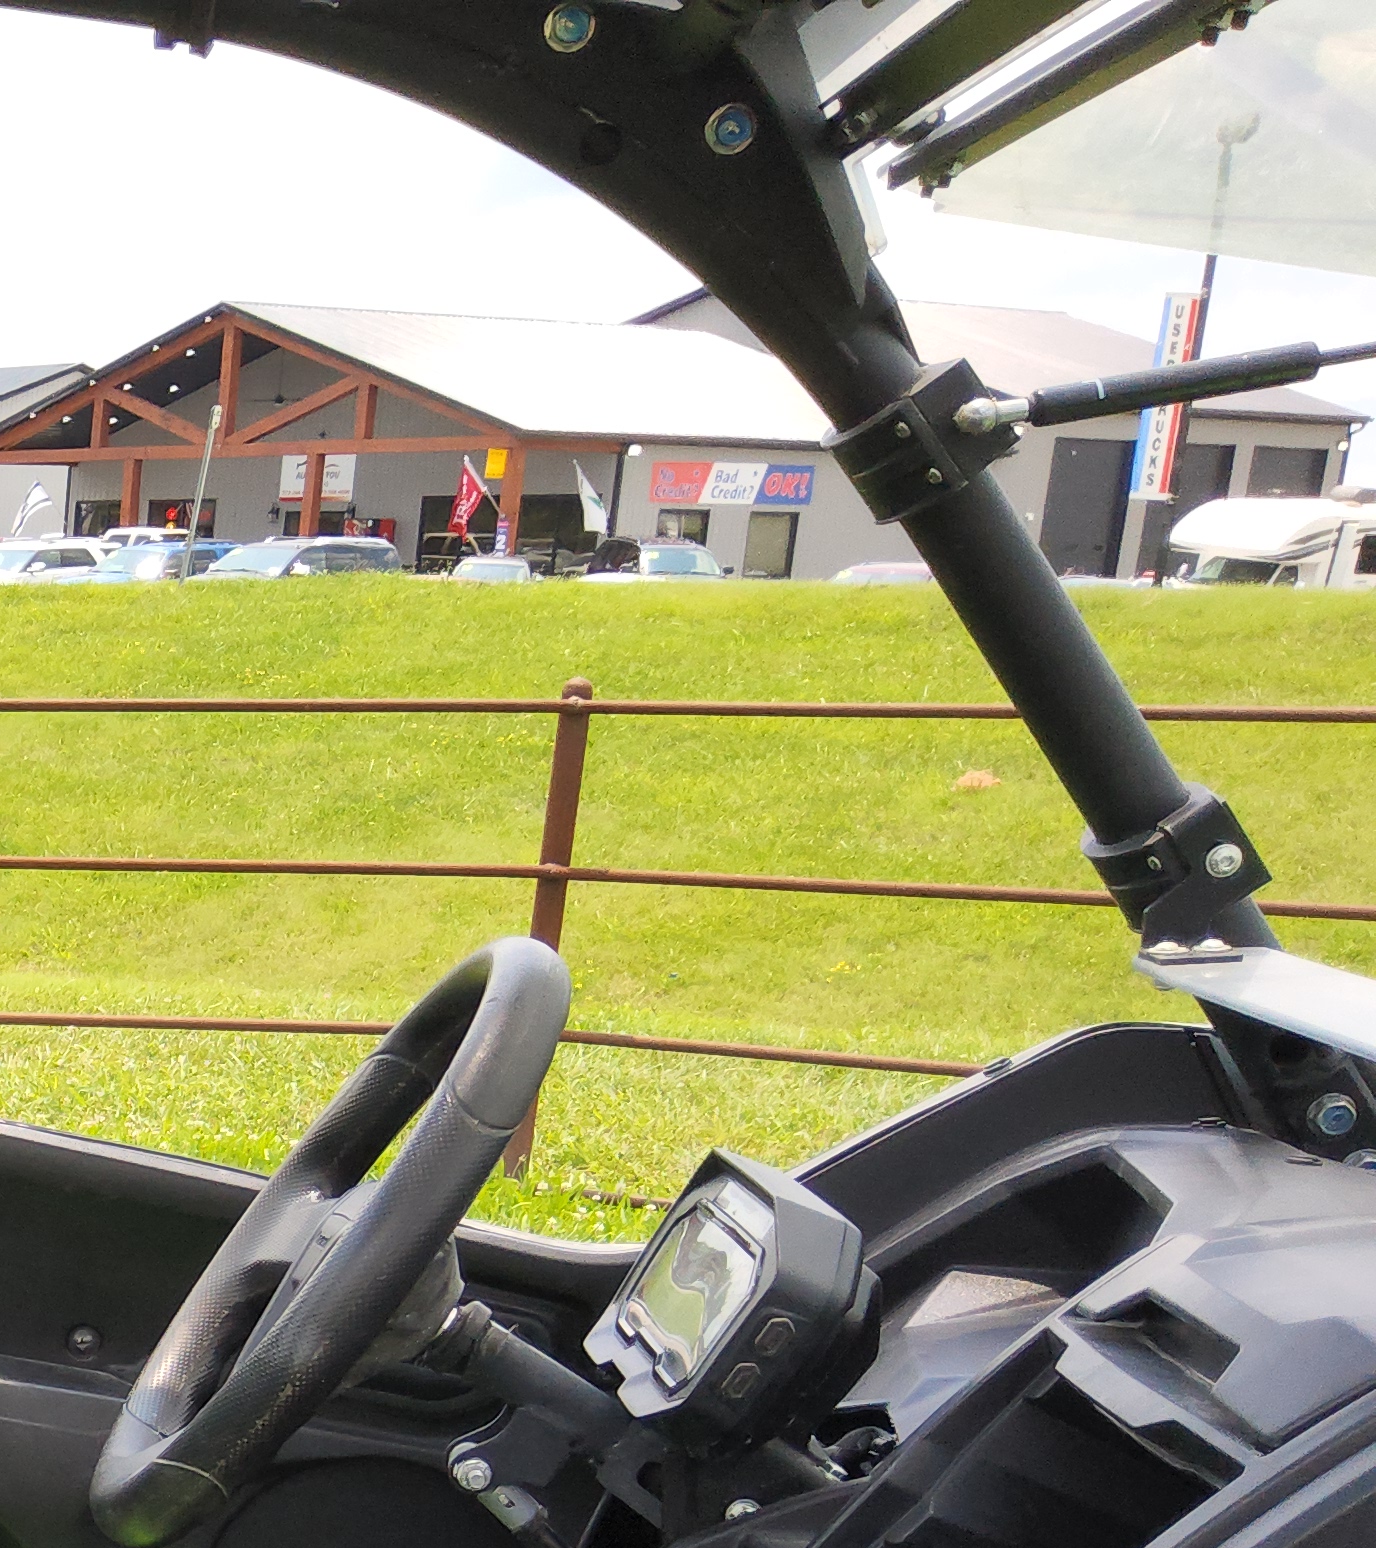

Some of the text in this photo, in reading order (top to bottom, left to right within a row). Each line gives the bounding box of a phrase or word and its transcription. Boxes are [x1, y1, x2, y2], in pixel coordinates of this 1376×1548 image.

[714, 469, 740, 484] Bad
[711, 485, 754, 499] Credit?
[764, 472, 810, 499] OK!
